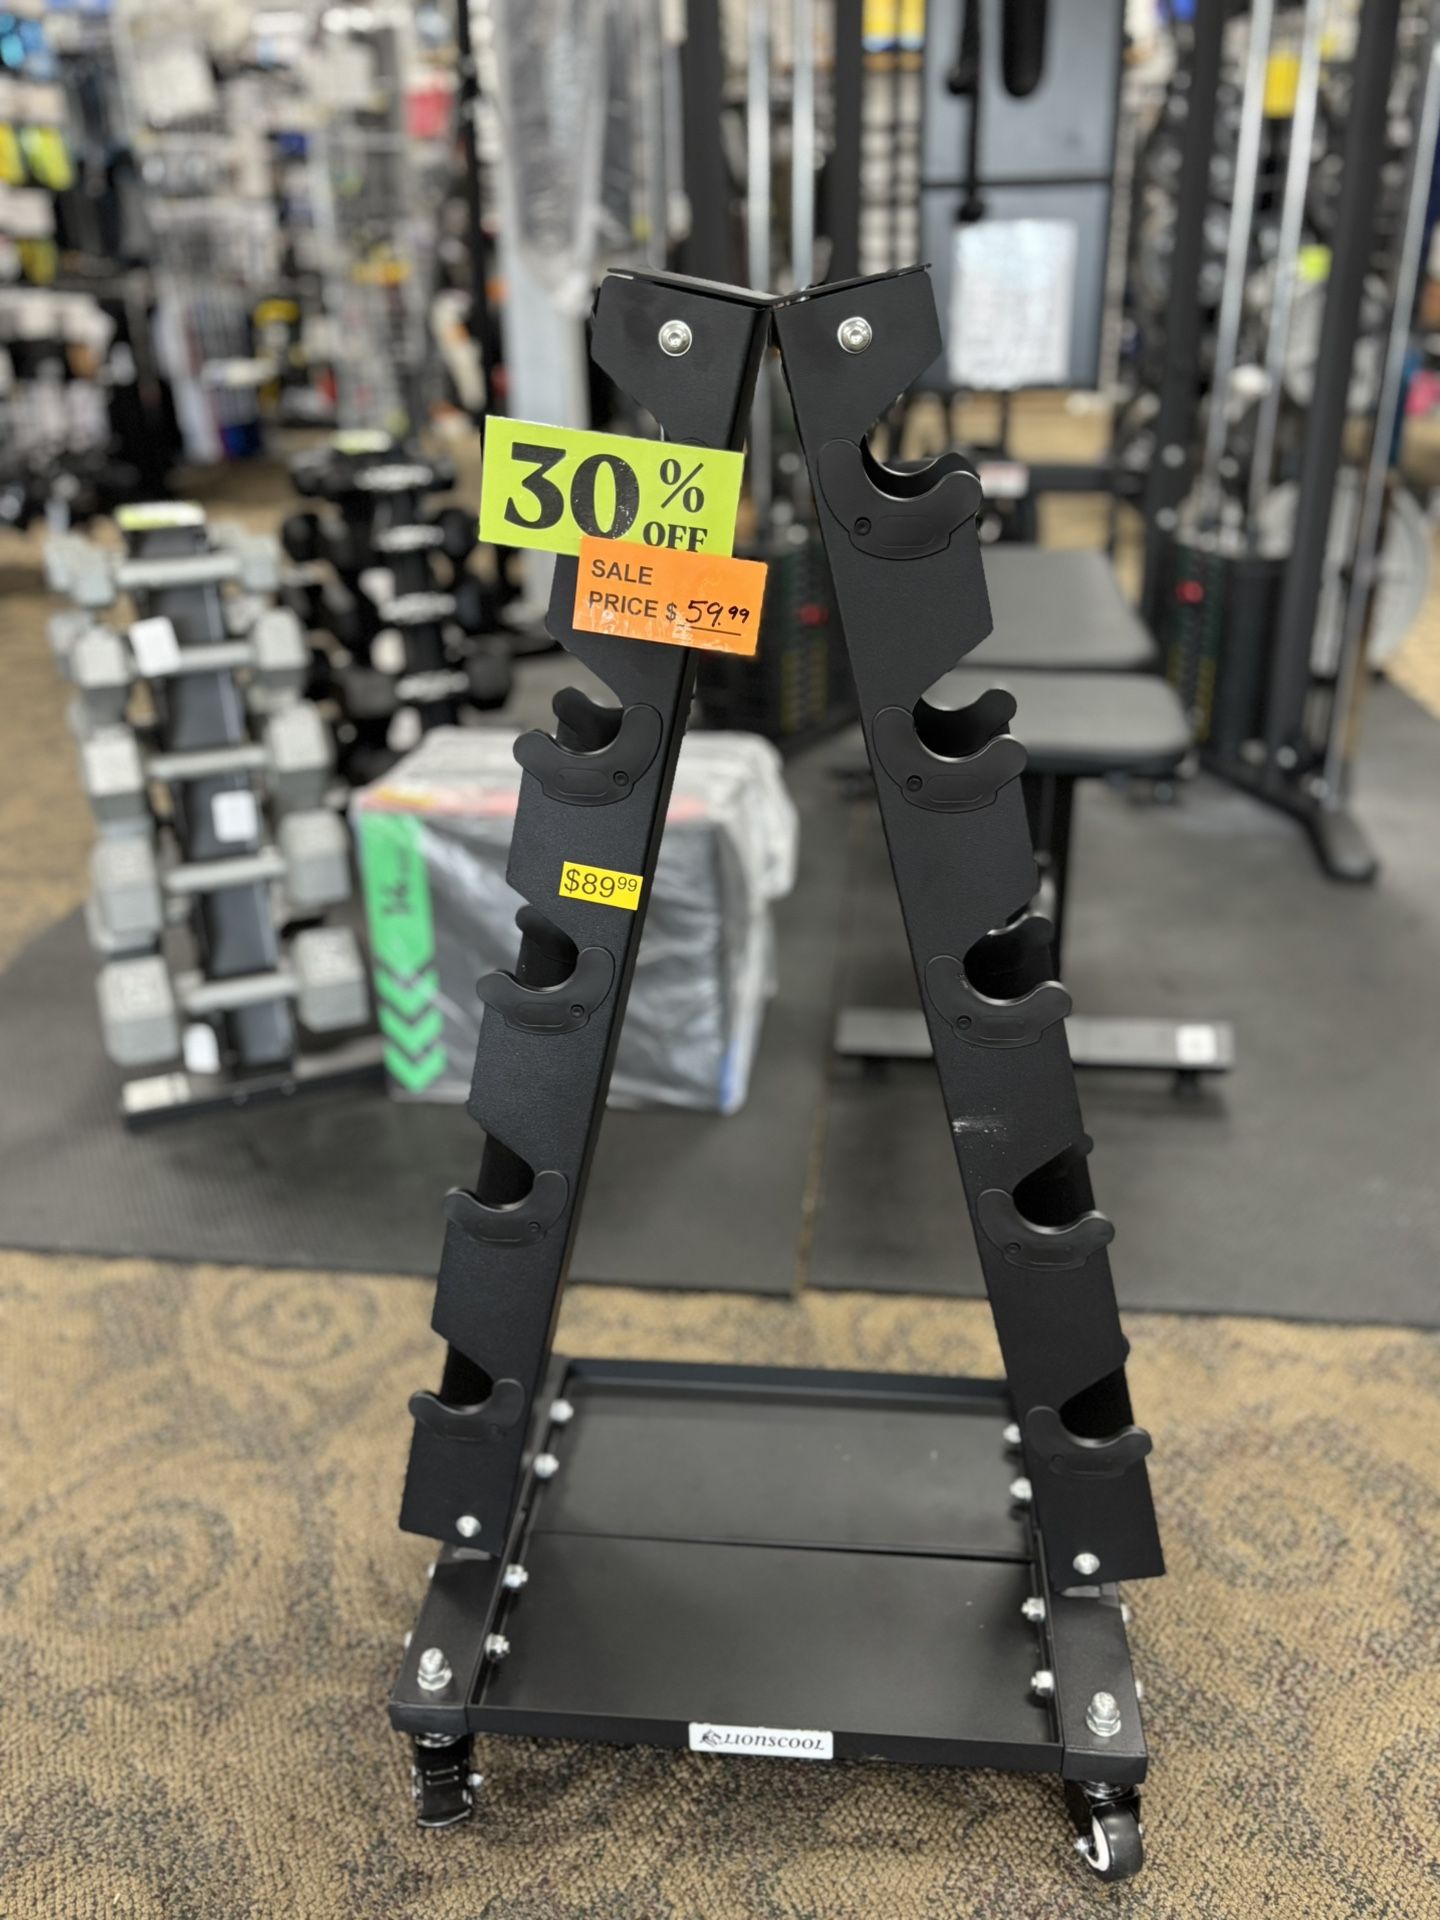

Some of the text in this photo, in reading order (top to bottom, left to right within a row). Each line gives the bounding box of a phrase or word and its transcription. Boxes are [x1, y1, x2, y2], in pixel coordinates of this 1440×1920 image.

[643, 521, 708, 553] OFF
[591, 559, 653, 586] SALE
[588, 590, 659, 618] PRICE
